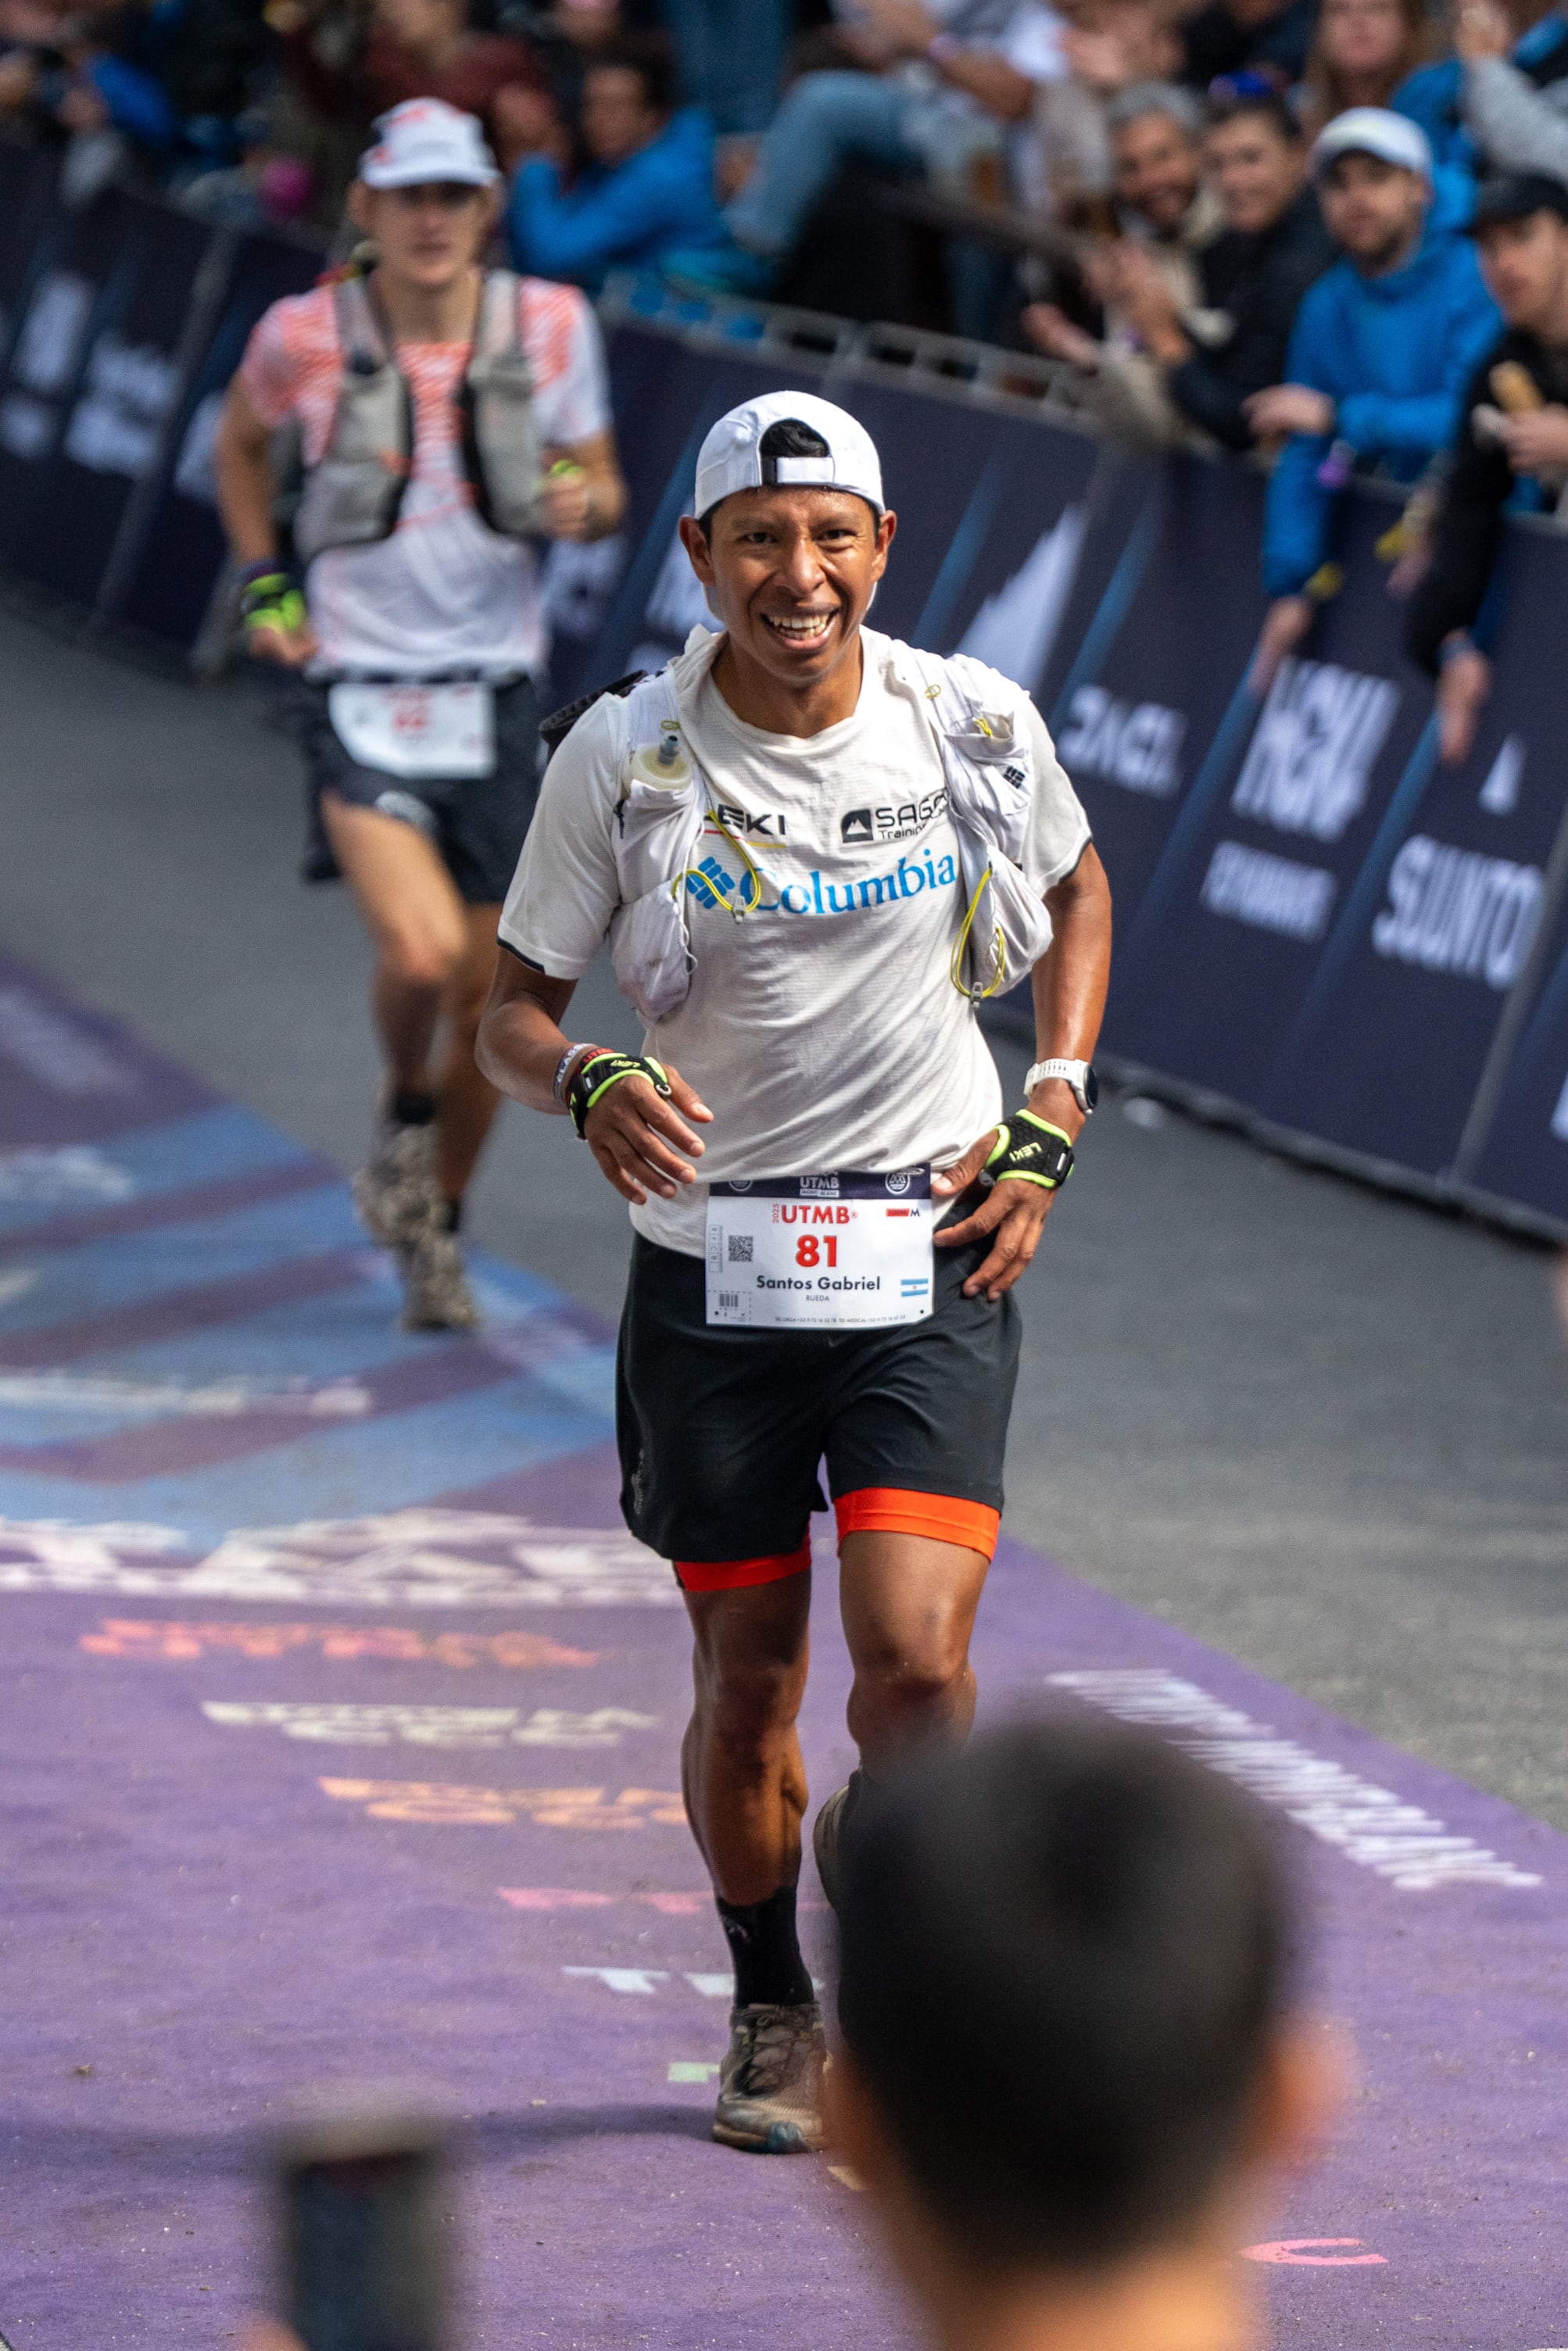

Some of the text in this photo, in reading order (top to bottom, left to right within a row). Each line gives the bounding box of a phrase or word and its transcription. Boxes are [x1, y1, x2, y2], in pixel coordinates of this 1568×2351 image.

[739, 849, 956, 914] Columbia
[1009, 1142, 1043, 1163] LEKI
[800, 1176, 839, 1189] UTMB
[796, 1234, 837, 1268] 81
[757, 1275, 880, 1290] Santos Gabriel
